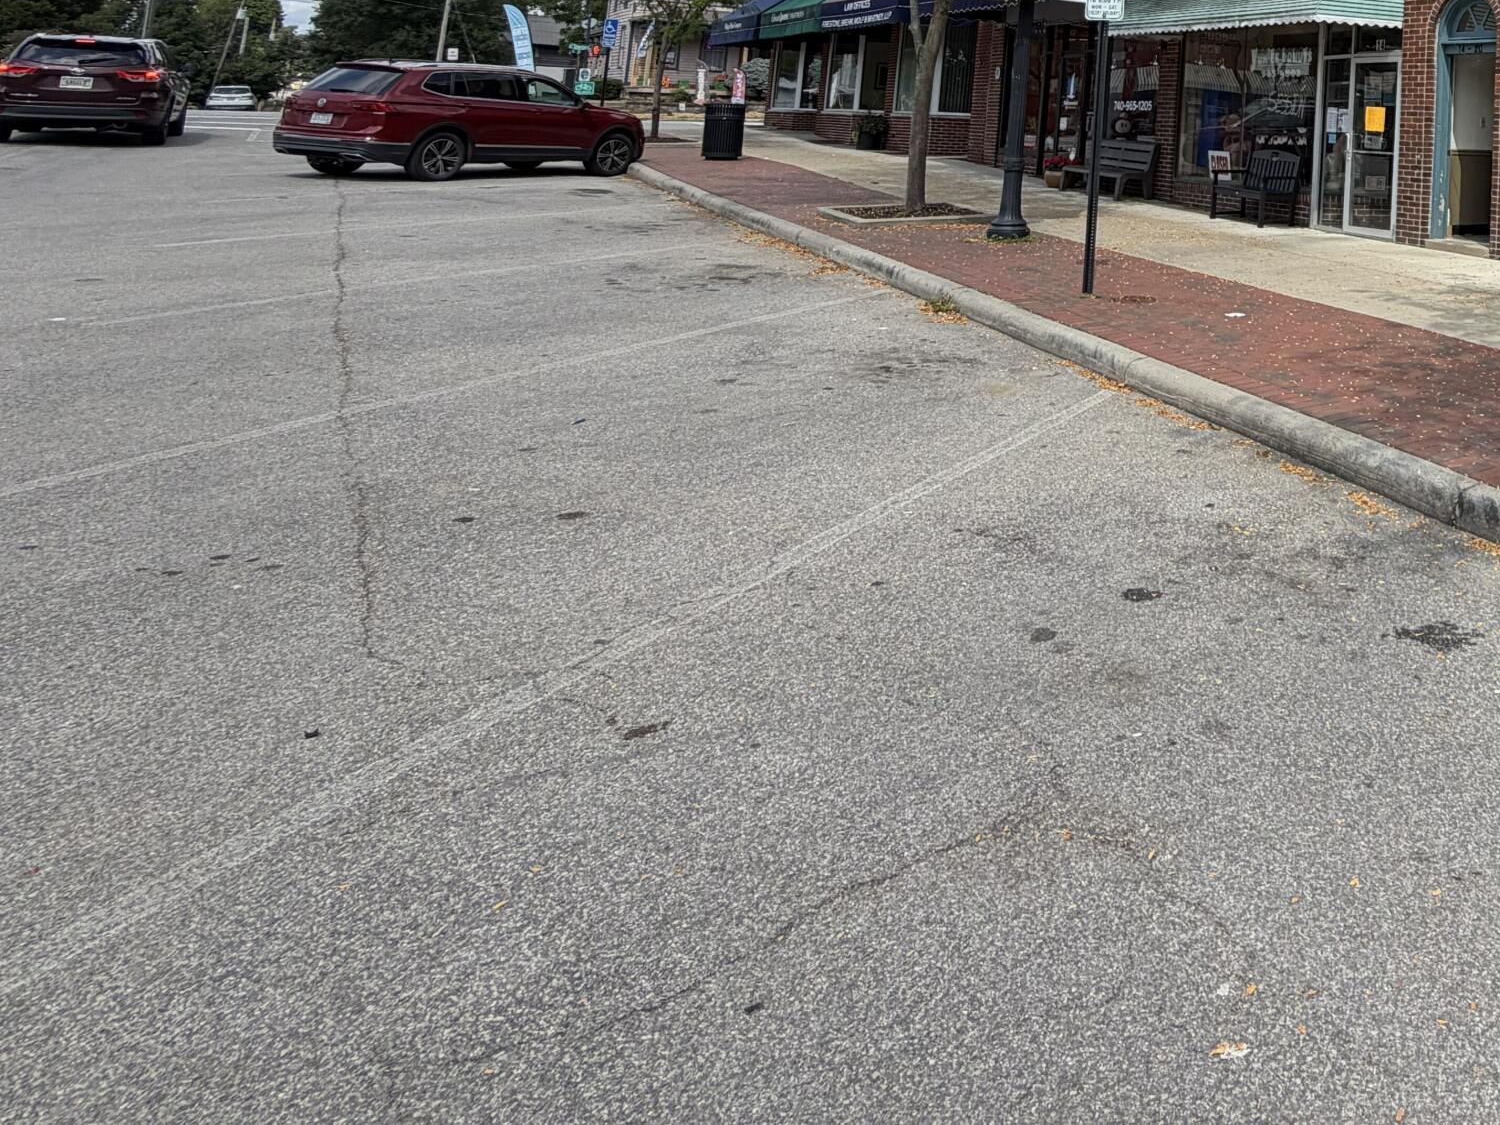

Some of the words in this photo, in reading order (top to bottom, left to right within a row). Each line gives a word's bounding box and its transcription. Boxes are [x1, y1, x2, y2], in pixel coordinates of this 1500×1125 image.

[843, 2, 853, 12] LAW
[853, 0, 871, 10] OFFICES
[1113, 100, 1153, 111] 740-965-1205
